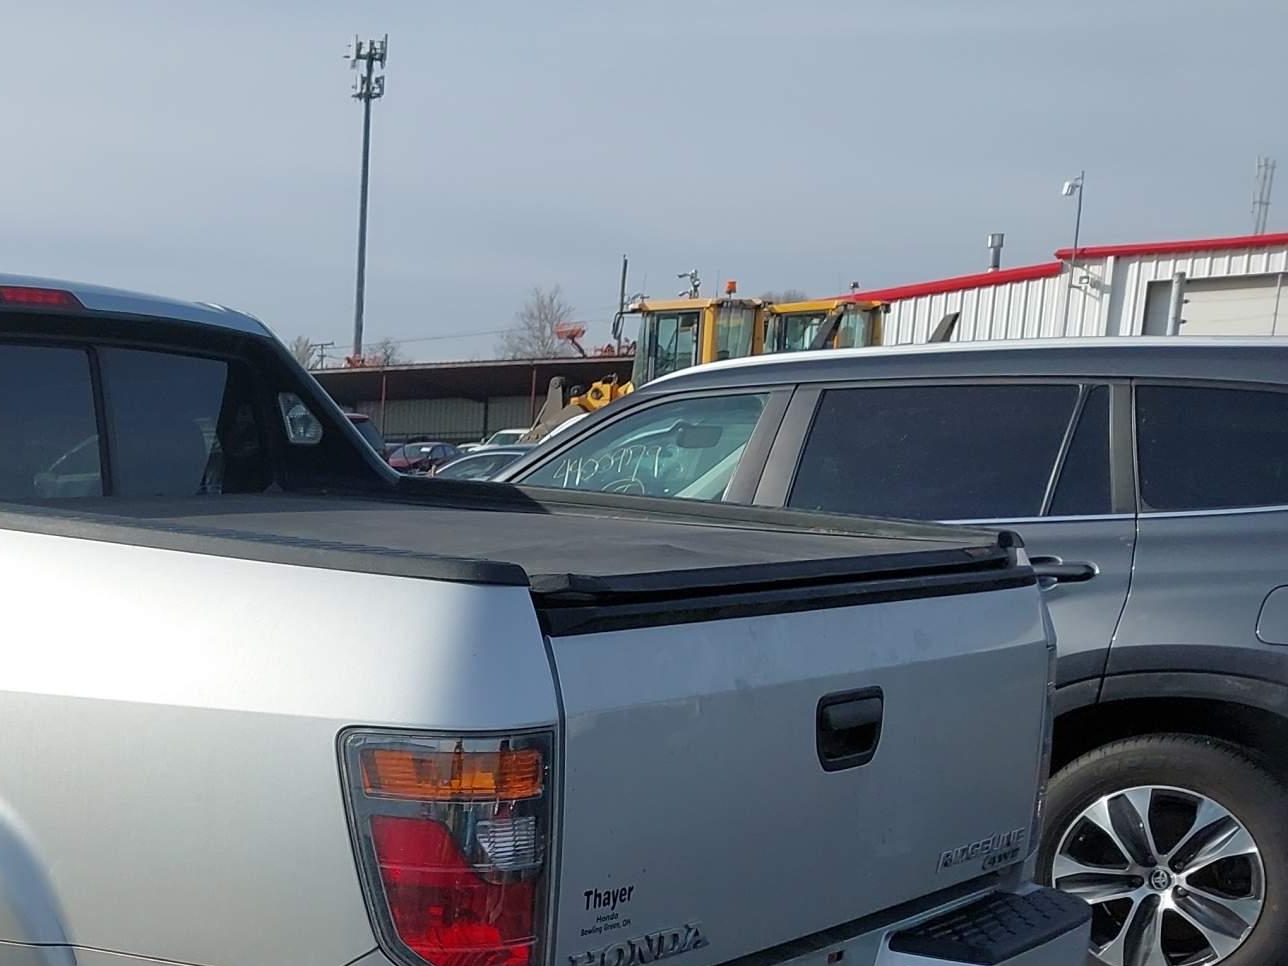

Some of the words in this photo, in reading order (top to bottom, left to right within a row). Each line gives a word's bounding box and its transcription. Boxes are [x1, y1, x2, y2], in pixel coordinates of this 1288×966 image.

[936, 827, 1026, 874] RIDGELINE
[584, 885, 634, 911] Thayer
[596, 911, 619, 923] Honda
